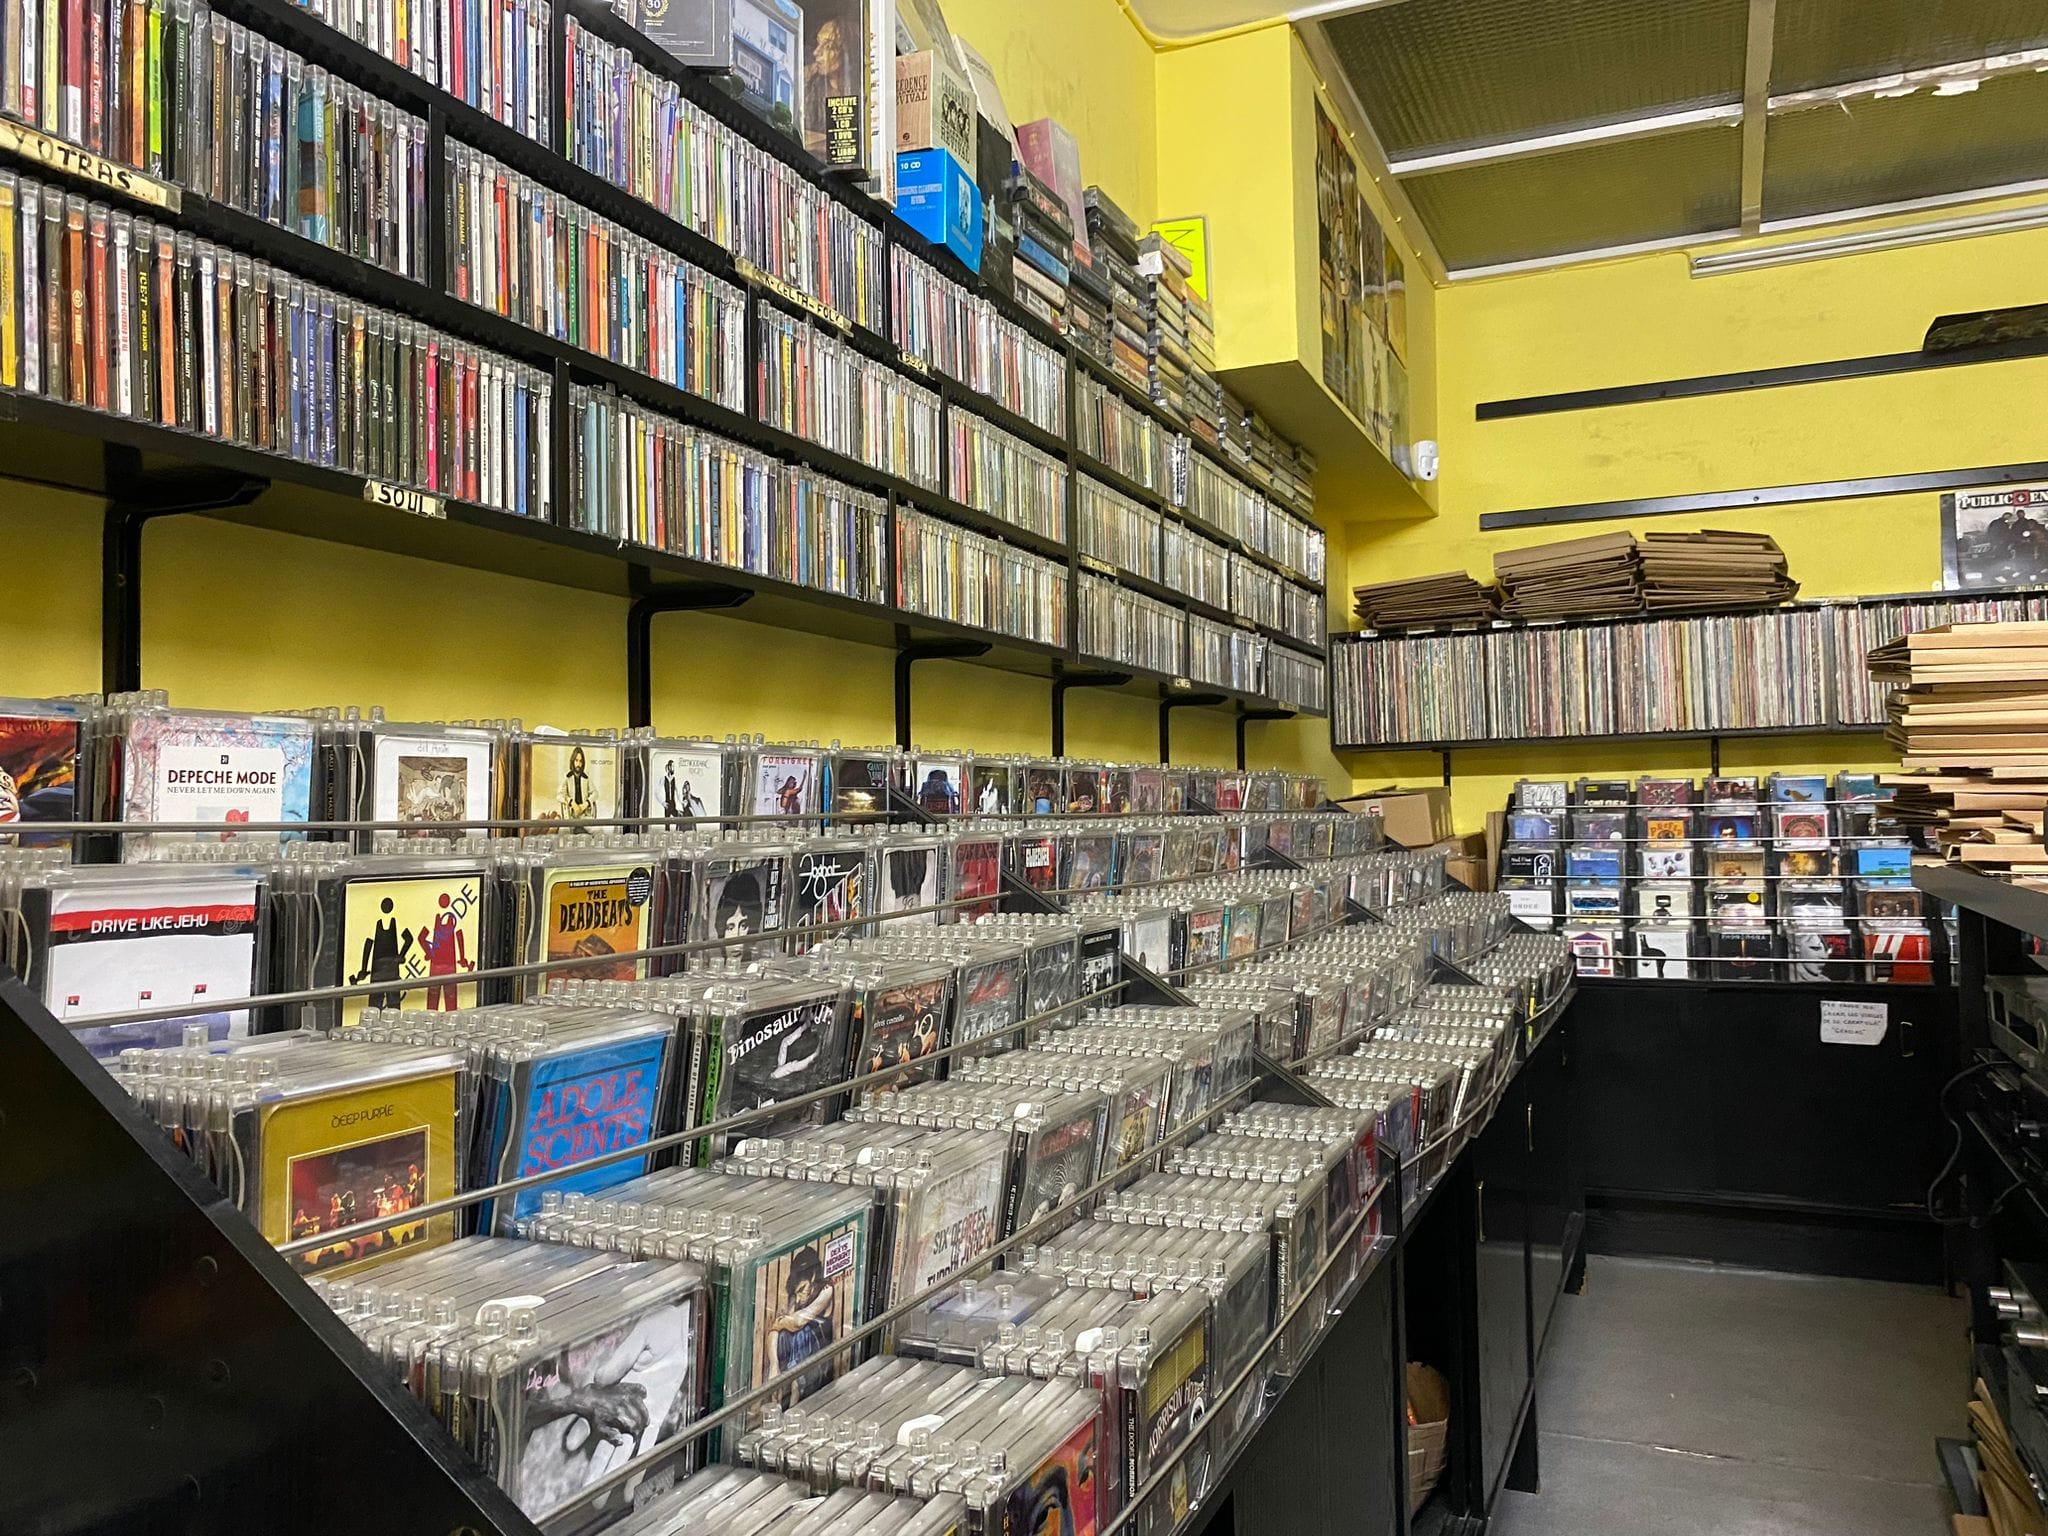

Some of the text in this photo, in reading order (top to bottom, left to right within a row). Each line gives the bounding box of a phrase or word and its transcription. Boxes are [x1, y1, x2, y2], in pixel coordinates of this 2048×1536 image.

[910, 161, 921, 169] CD
[140, 272, 148, 305] ICE-T
[1960, 492, 2013, 510] PUBLIC
[167, 769, 277, 785] DEPECHE MODE
[167, 786, 276, 795] NEVER LET ME DOWN AGAIN
[587, 889, 608, 900] THE
[91, 913, 209, 934] DRIVE LIKE JEHU
[559, 898, 633, 934] DEADBEATS
[726, 1004, 804, 1066] Dinosaur
[912, 1013, 934, 1039] 10
[688, 1042, 702, 1111] CREAM OF DIVINE
[530, 1069, 649, 1132] ADOLE-
[331, 1103, 395, 1129] DEEP PURPLE
[524, 1107, 646, 1177] SCENTS
[830, 1243, 848, 1258] DEXYS
[526, 1356, 561, 1392] Dead
[1128, 1458, 1136, 1498] MORRISON
